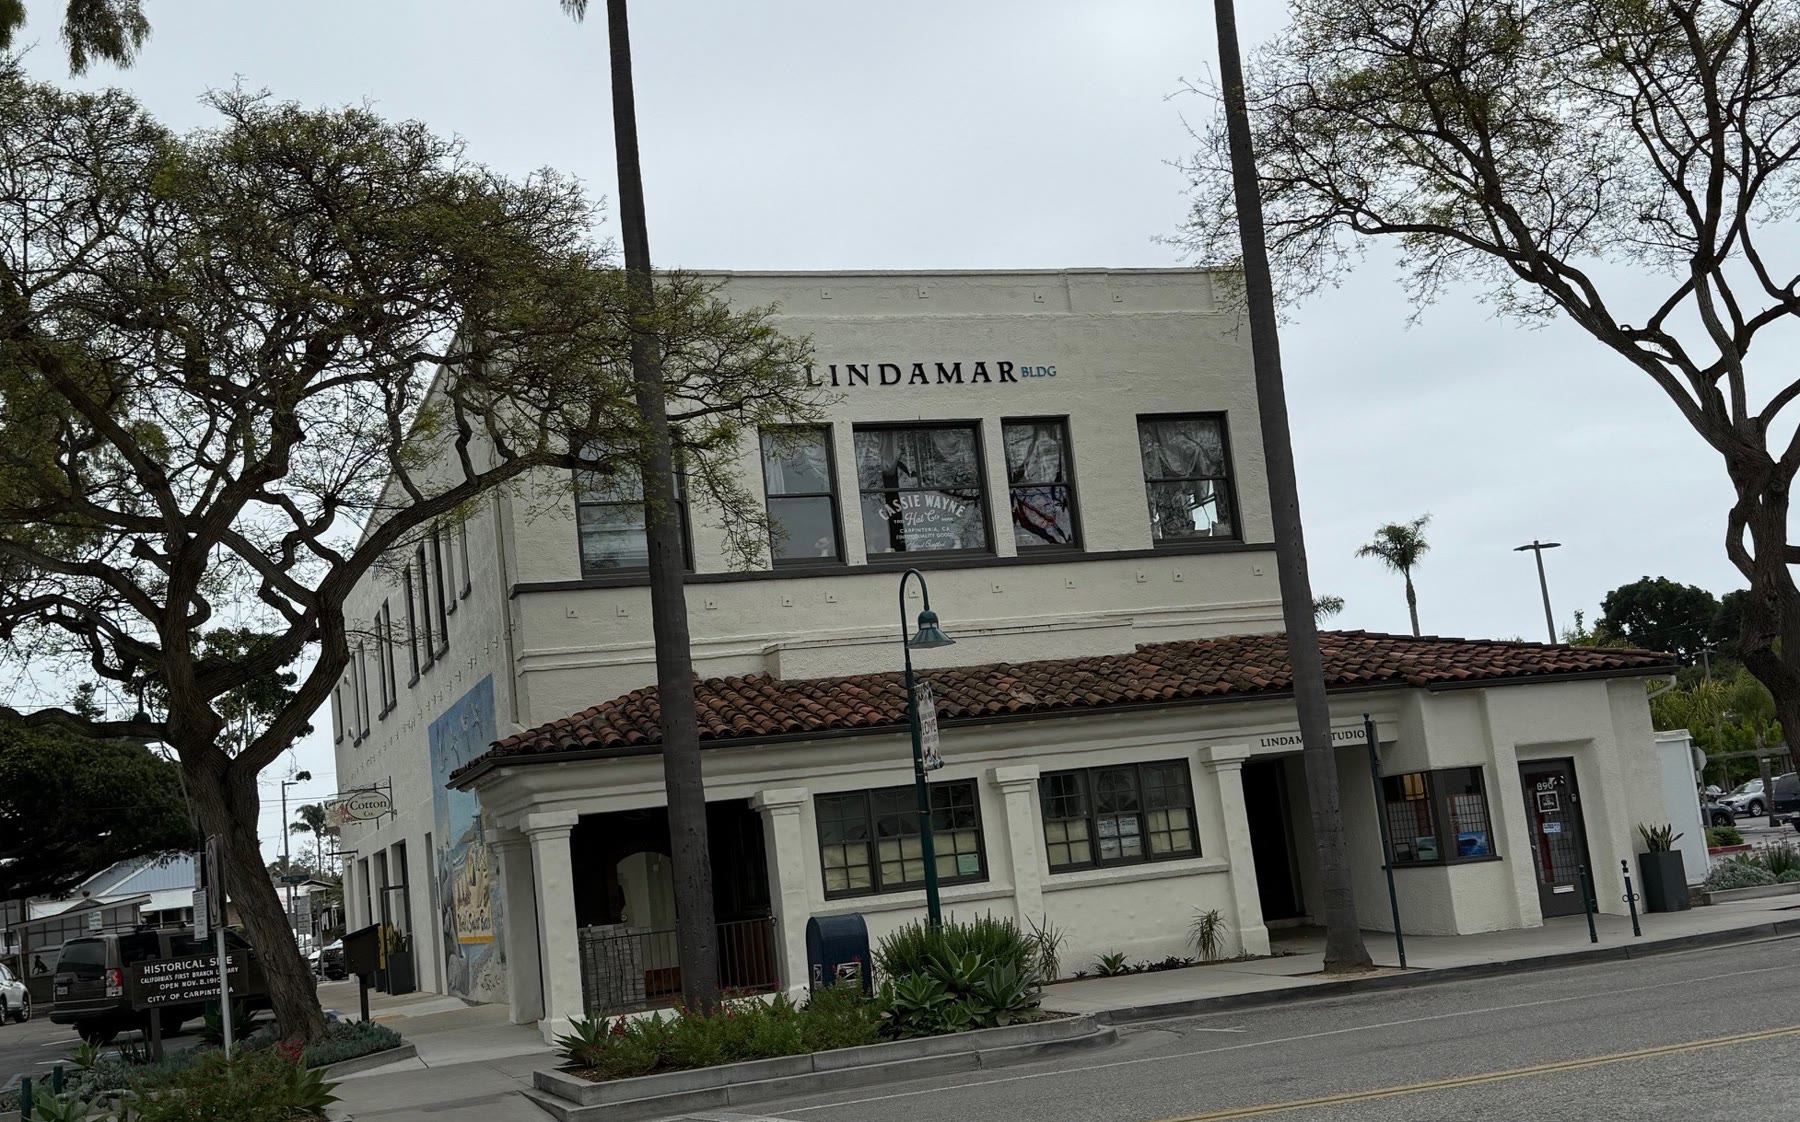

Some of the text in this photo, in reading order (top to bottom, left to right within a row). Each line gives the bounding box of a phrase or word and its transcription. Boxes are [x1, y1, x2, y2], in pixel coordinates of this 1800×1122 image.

[804, 361, 1057, 387] LINDAMAR BLDG
[878, 494, 966, 521] CASSIE WAYNE
[904, 511, 925, 526] Hat
[1536, 781, 1554, 791] 890
[350, 800, 387, 811] Cotton
[144, 955, 233, 975] HISTORICAL SIE
[174, 972, 190, 980] FIRST
[192, 969, 214, 978] BRANCH
[159, 982, 179, 990] OPEN
[147, 995, 166, 1003] CITY
[183, 986, 234, 999] CARPINTEA
